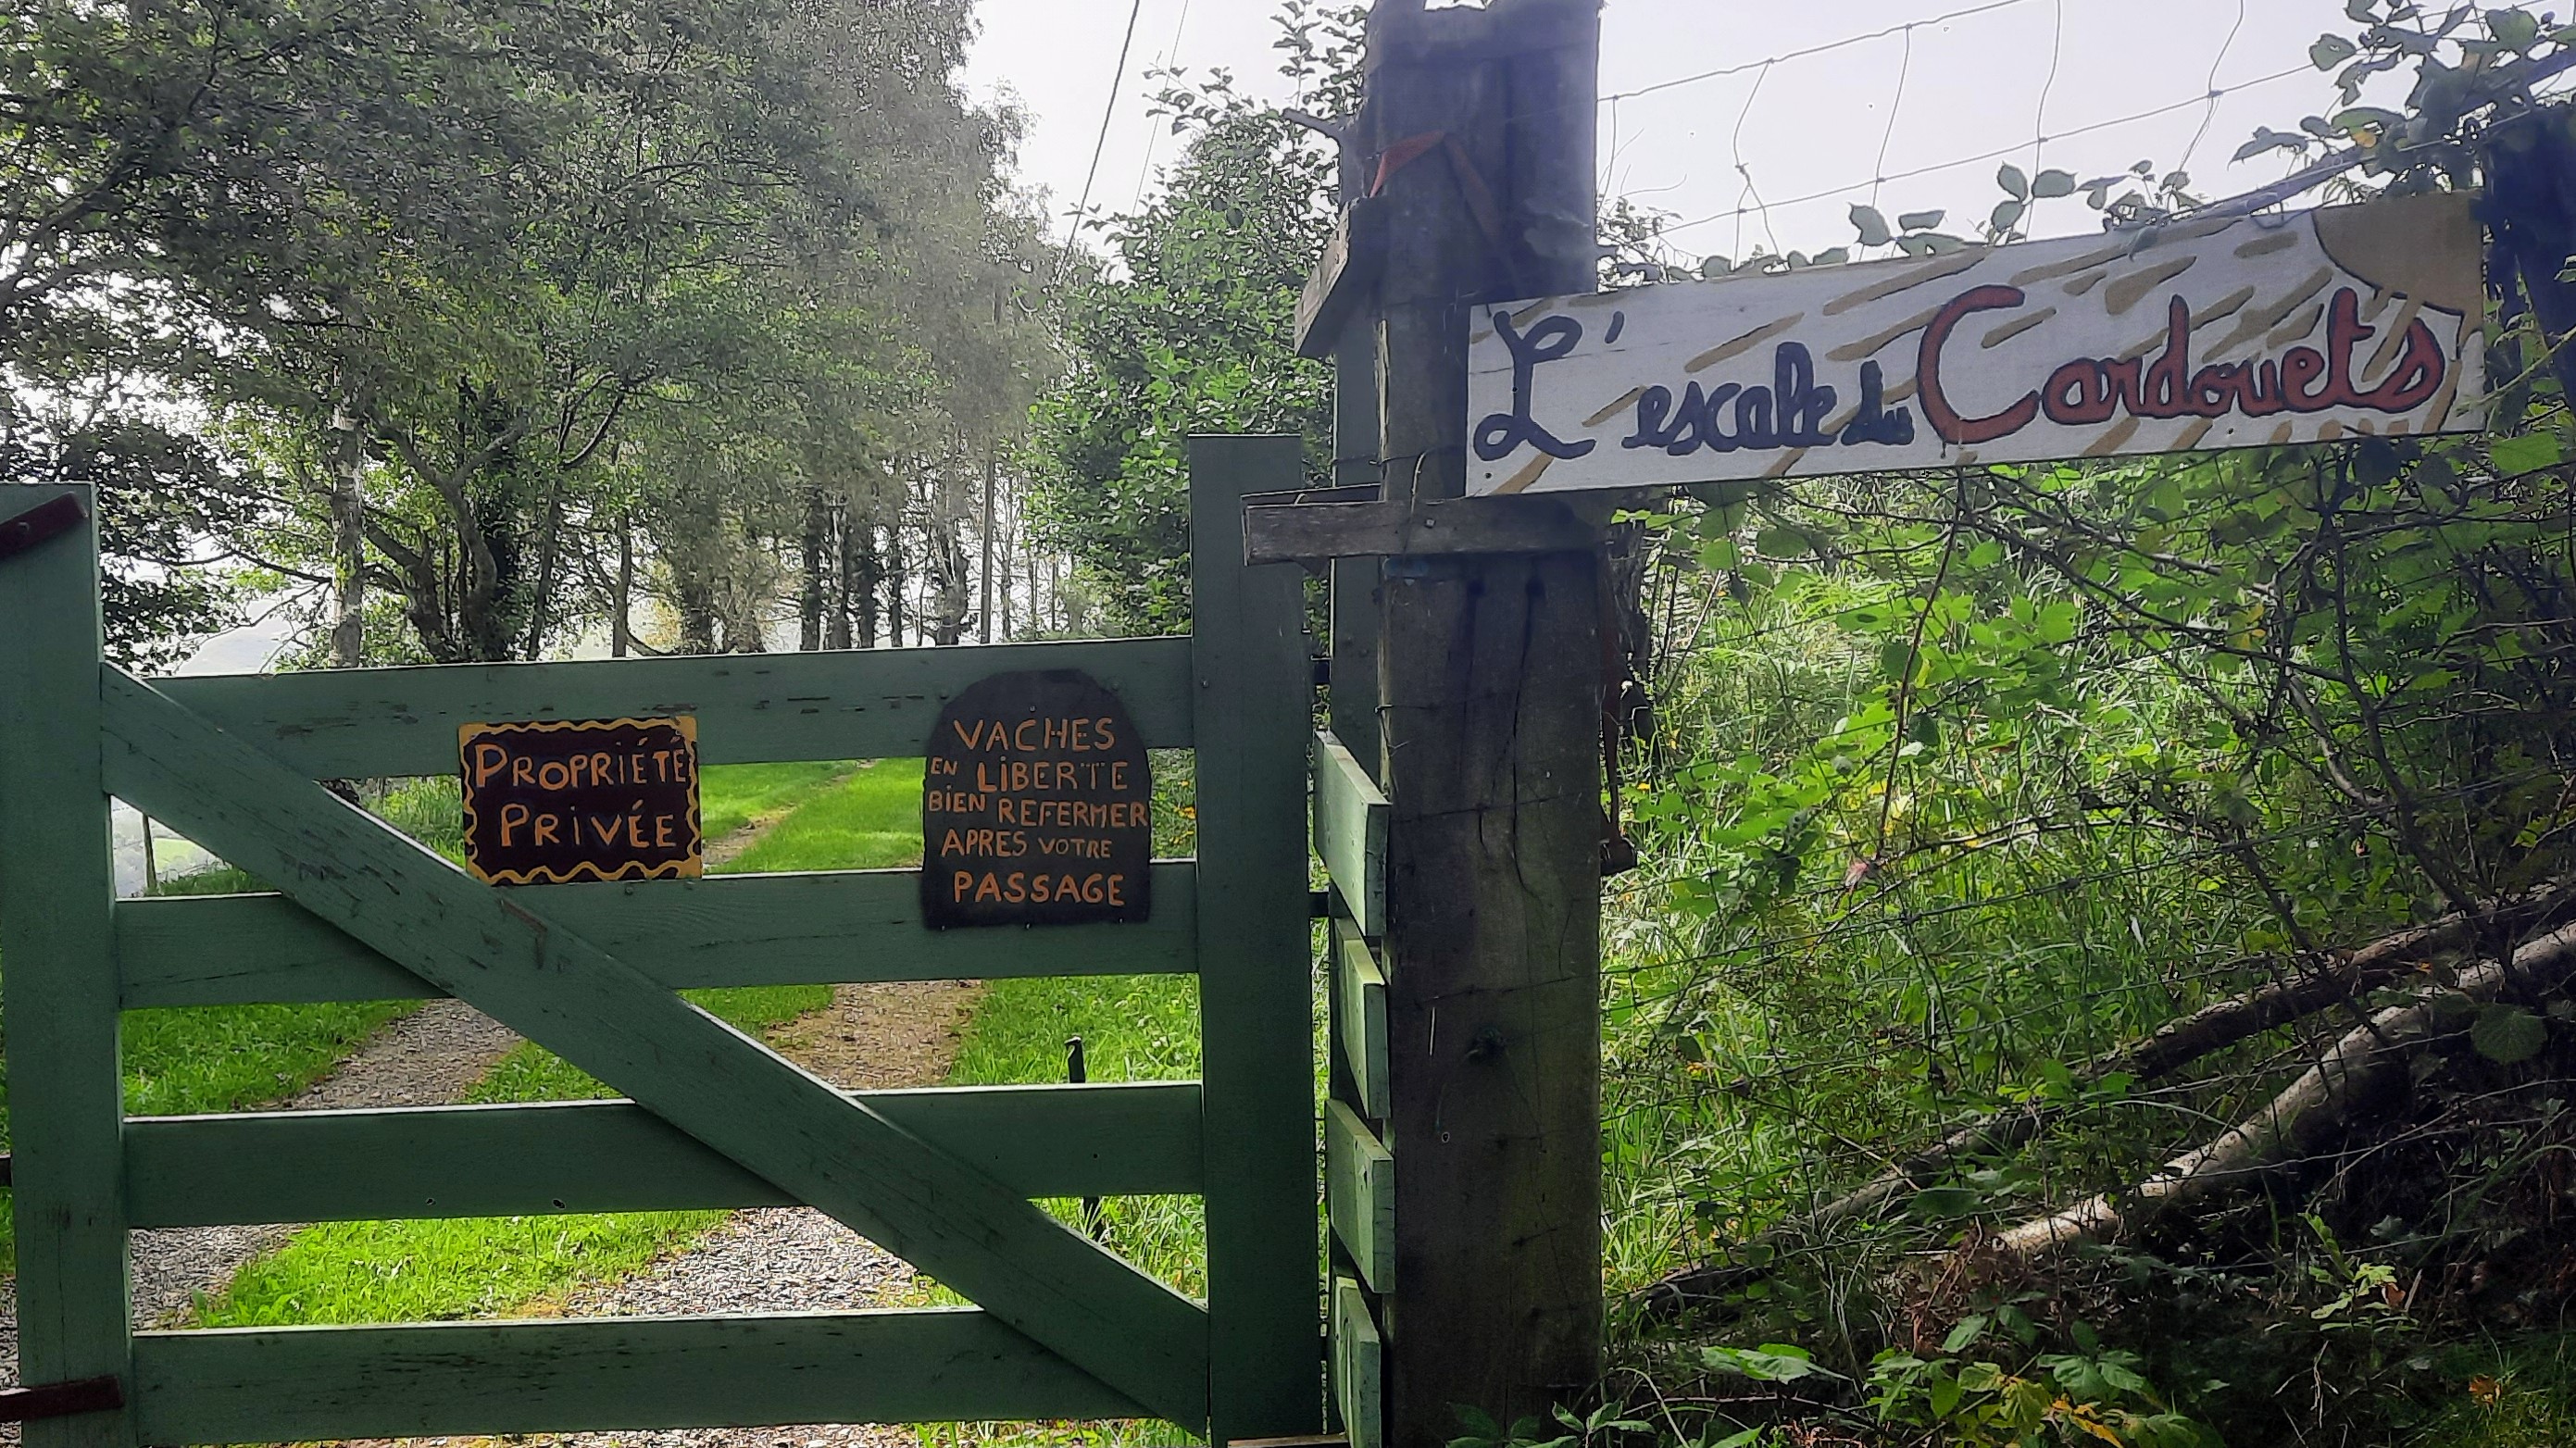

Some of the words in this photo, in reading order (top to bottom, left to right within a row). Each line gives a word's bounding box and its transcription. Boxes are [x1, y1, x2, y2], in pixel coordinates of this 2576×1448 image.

[1917, 284, 2445, 444] Cardouets
[953, 718, 1116, 752] VACHES
[930, 757, 957, 776] EN
[998, 798, 1149, 829] REFERMER
[941, 829, 1029, 858] APRES
[1037, 837, 1113, 859] VOTRE
[953, 870, 1126, 907] PASSAGE
